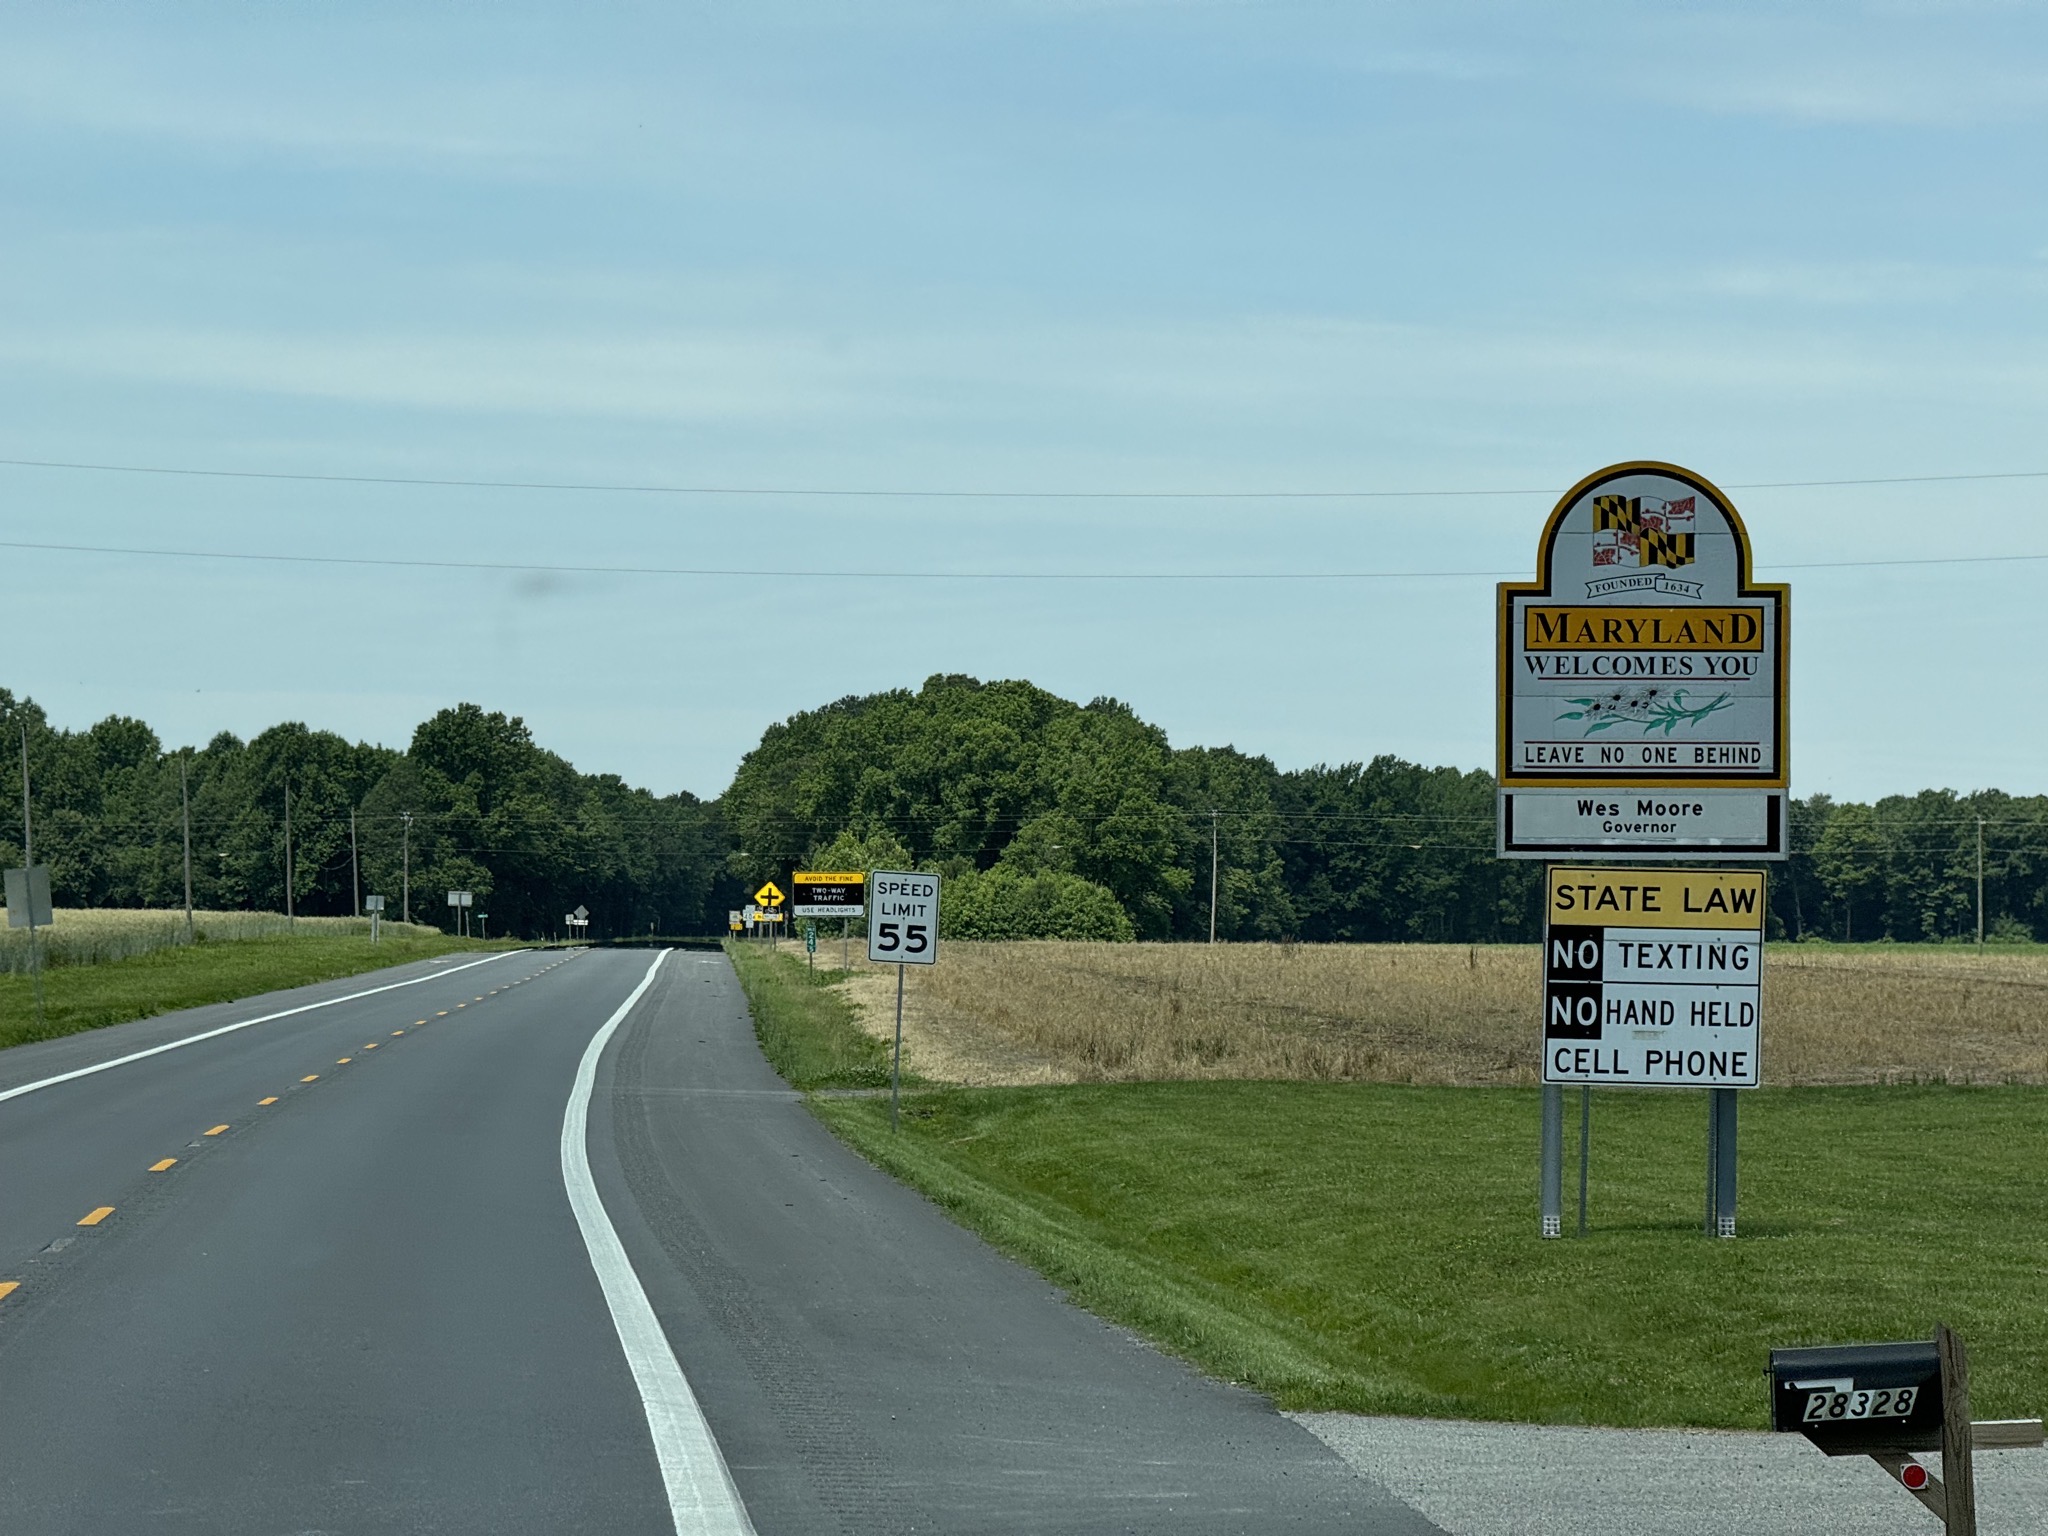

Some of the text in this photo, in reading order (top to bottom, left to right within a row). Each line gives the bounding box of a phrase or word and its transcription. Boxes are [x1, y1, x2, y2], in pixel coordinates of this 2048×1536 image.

[1595, 576, 1691, 594] FOUNDED 1634
[1533, 612, 1758, 644] MARYLAND
[1524, 655, 1760, 676] WELCOMES YOU
[1525, 746, 1762, 763] LEAVE NO ONE BEHIND
[1577, 800, 1703, 817] Wes Moore
[1602, 821, 1677, 834] Governor
[877, 881, 934, 898] SPEED
[1555, 884, 1757, 914] STATE LAW
[881, 902, 927, 918] LIMIT
[877, 923, 928, 954] 55
[1553, 939, 1749, 970] NO TEXTING
[1551, 996, 1754, 1028] NO HAND HELD
[1554, 1047, 1748, 1077] CELL PHONE
[1807, 1389, 1913, 1420] 28328
